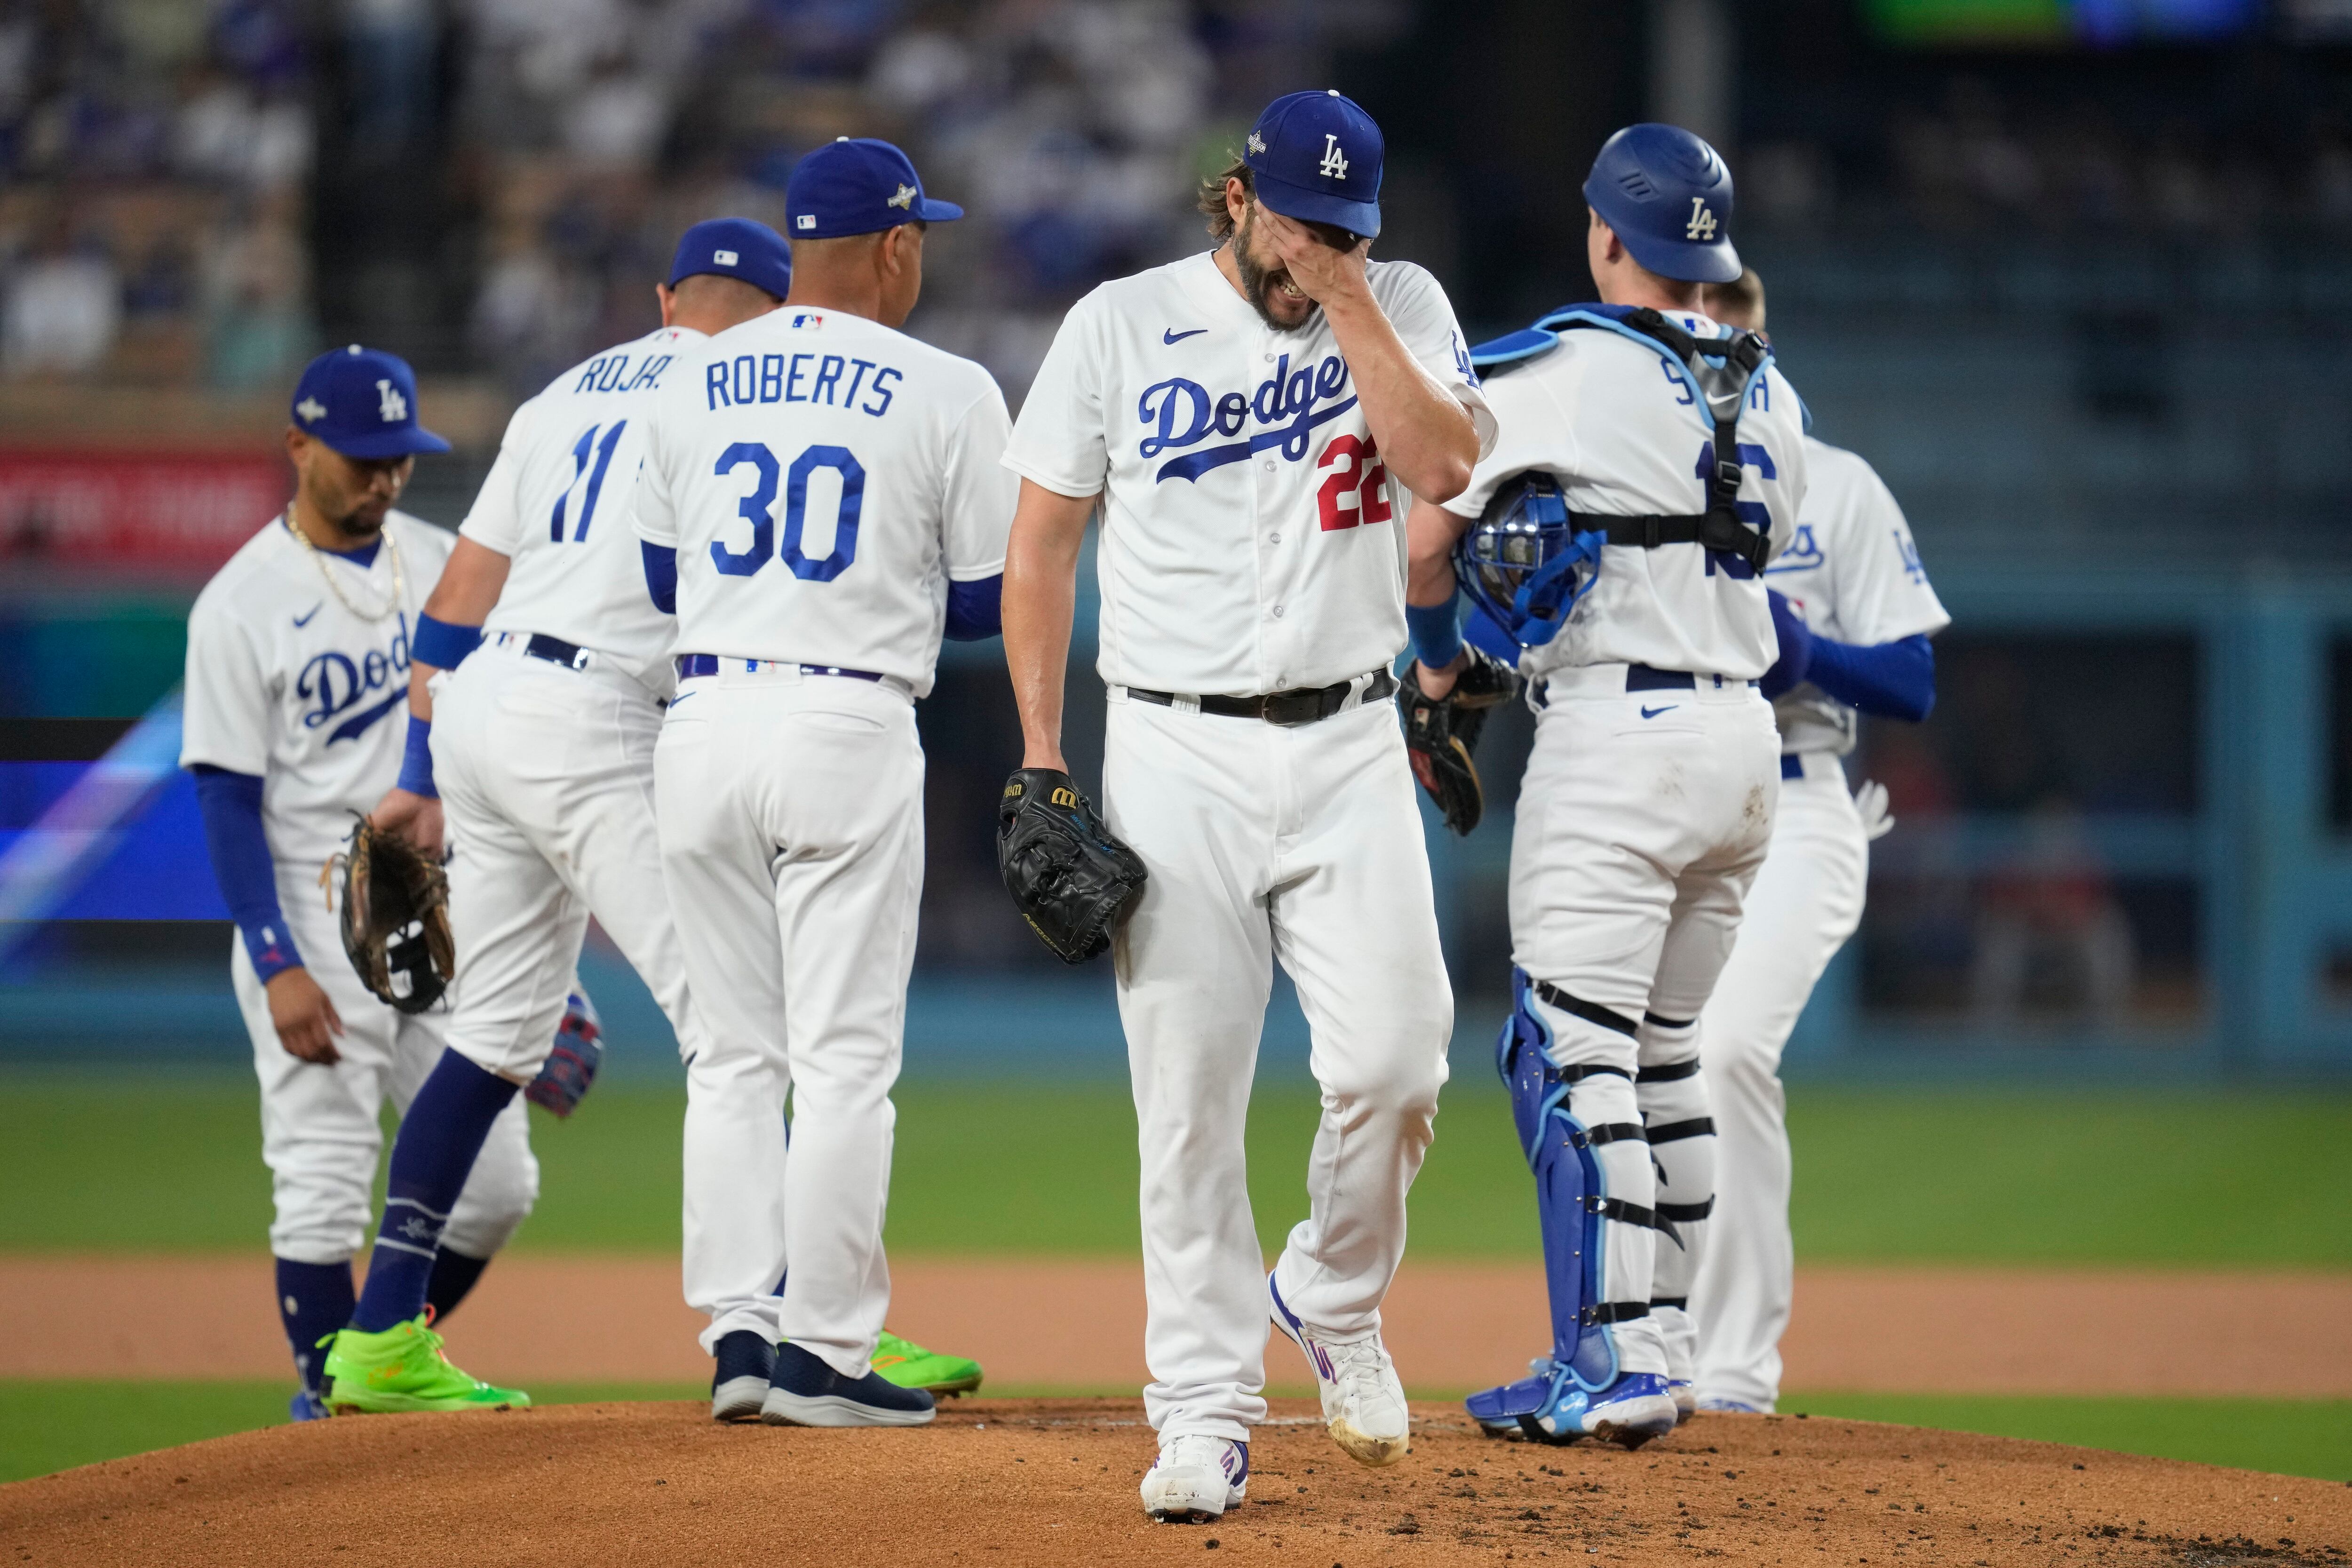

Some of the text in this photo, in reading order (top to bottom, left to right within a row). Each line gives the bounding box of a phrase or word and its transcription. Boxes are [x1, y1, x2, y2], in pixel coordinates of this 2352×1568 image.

[1320, 134, 1349, 180] LA
[1686, 197, 1718, 240] LA
[376, 379, 408, 422] LA
[574, 355, 675, 393] ROJA
[707, 354, 903, 417] ROBERTS
[1139, 353, 1349, 462] Dodge
[550, 418, 628, 542] 11
[710, 442, 866, 582] 30
[1317, 434, 1391, 532] 22
[297, 611, 411, 728] Dod
